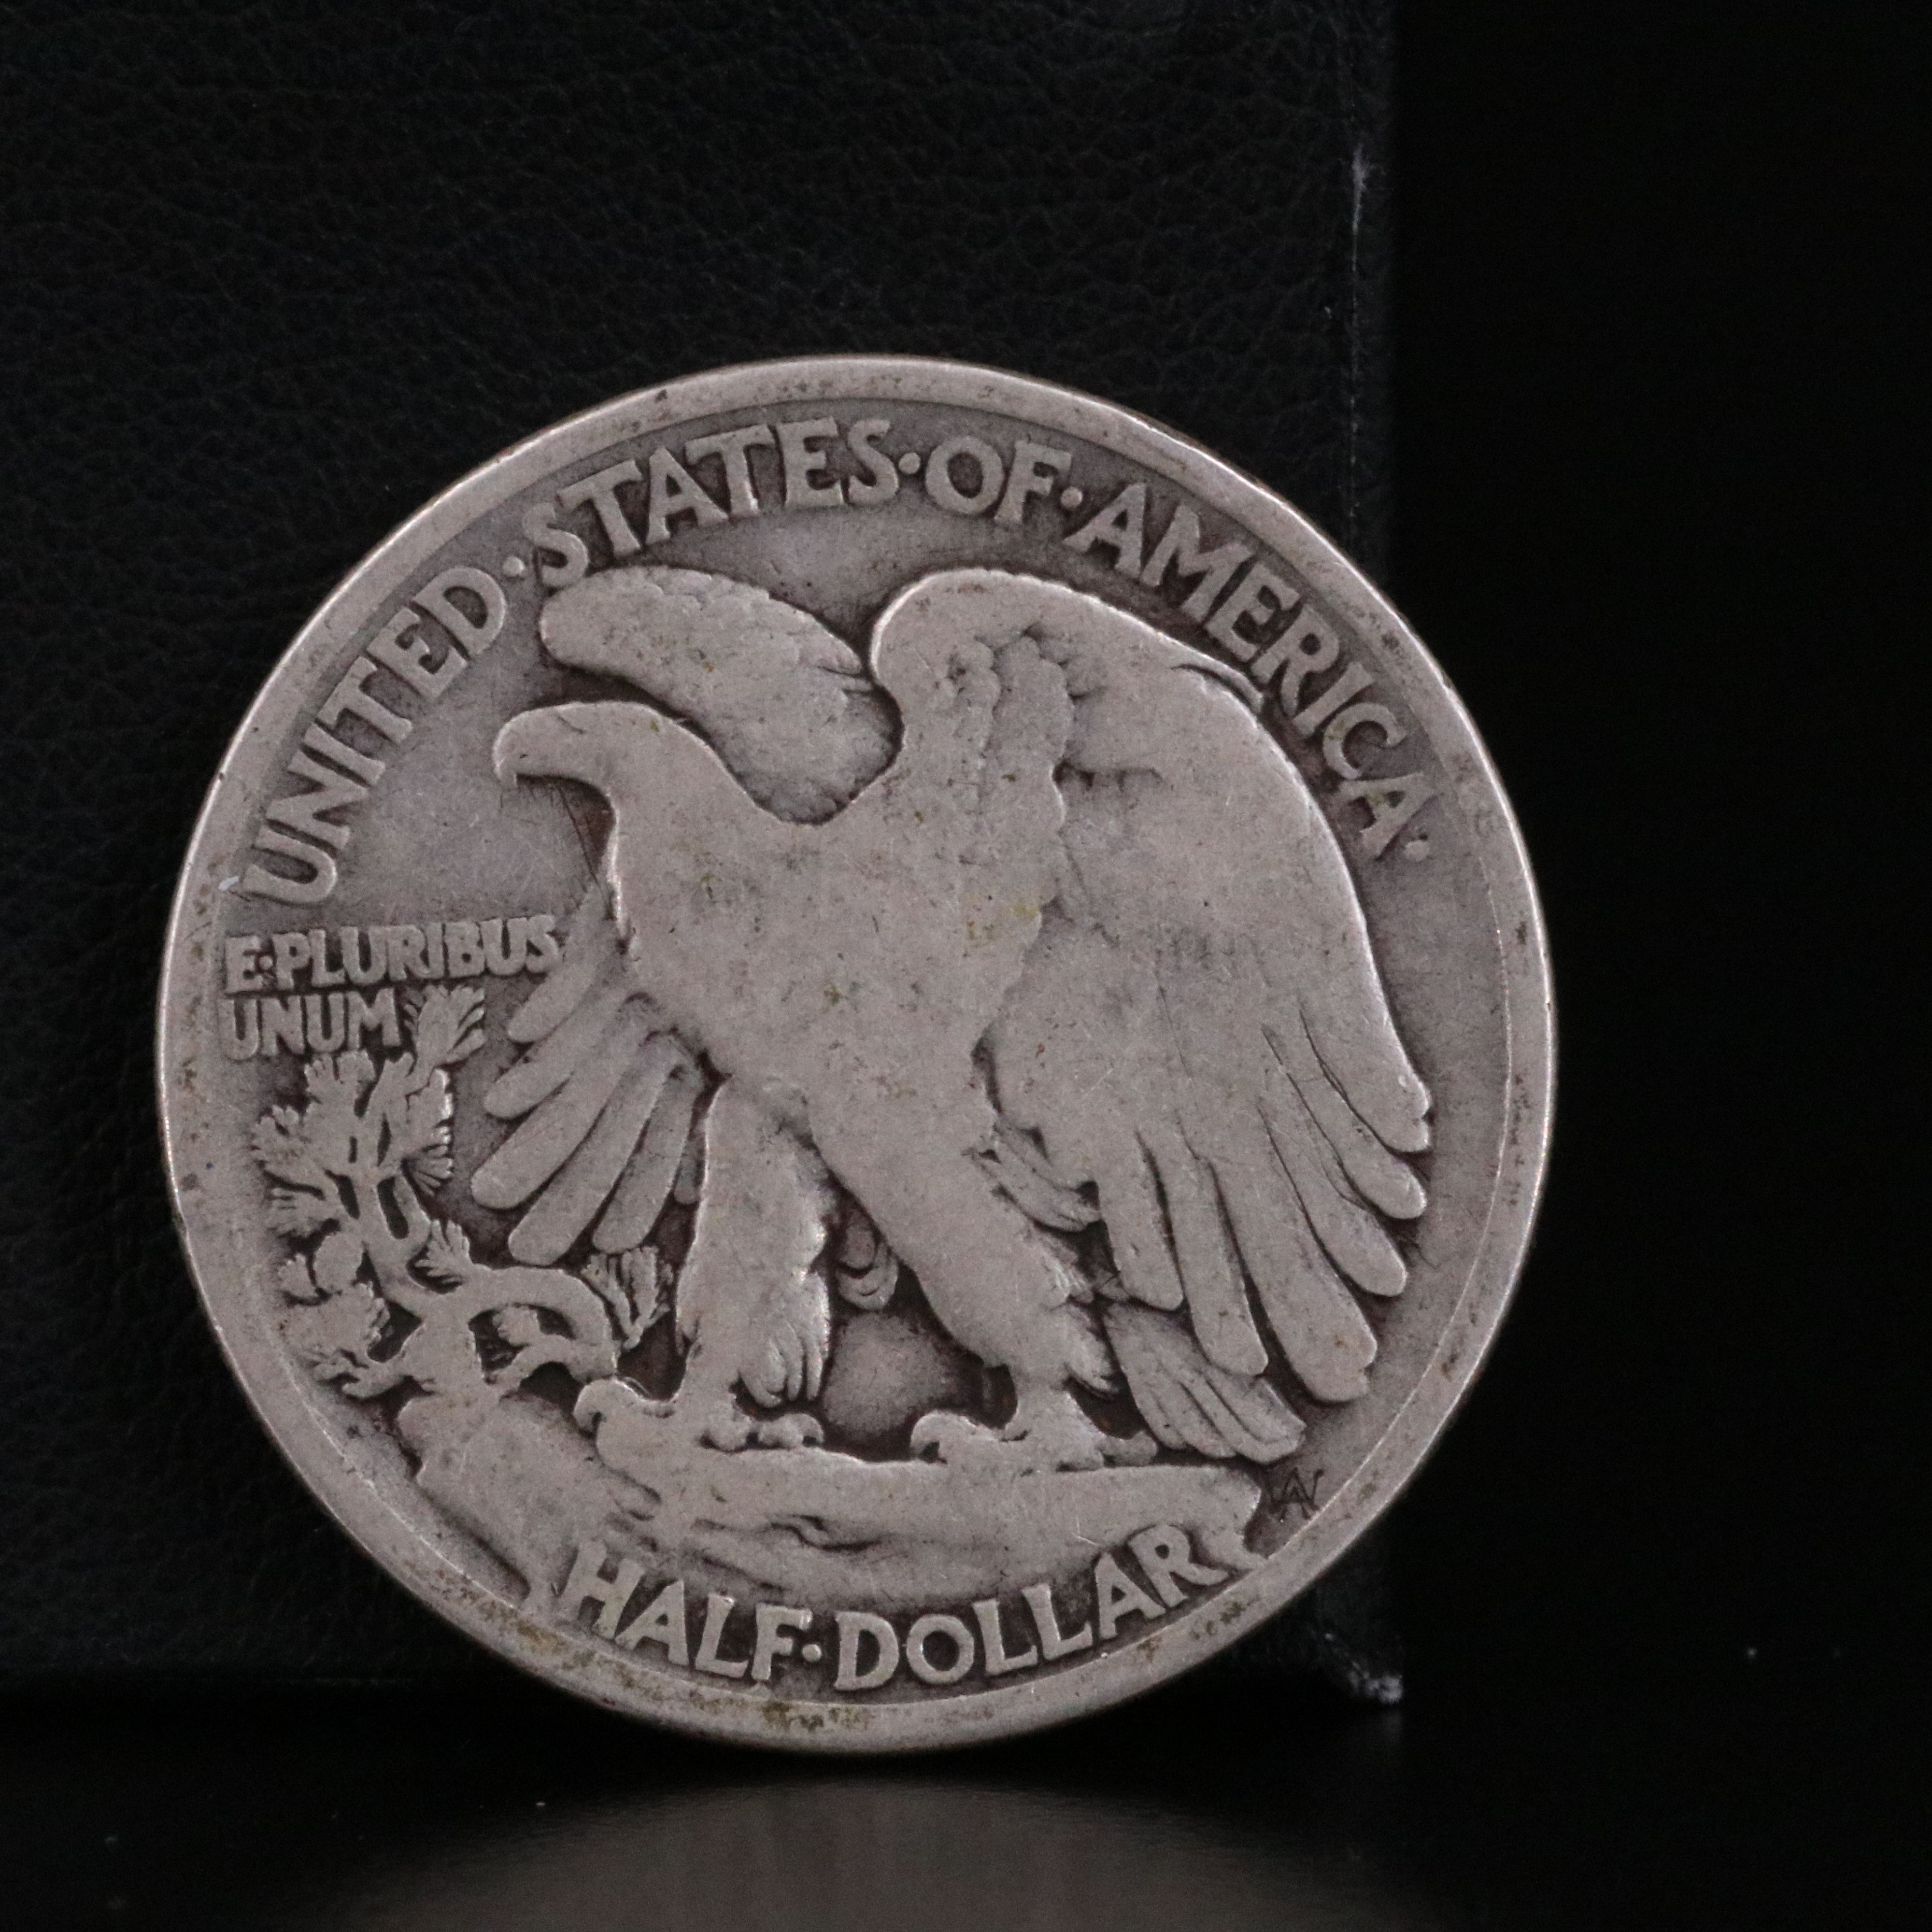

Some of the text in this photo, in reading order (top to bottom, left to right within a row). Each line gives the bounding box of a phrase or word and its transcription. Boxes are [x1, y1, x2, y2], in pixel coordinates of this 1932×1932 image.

[241, 416, 1443, 903] UNITED STATES OF AMERICA
[220, 988, 400, 1060] UNUM
[563, 1523, 1230, 1691] HALF DOLLAR
